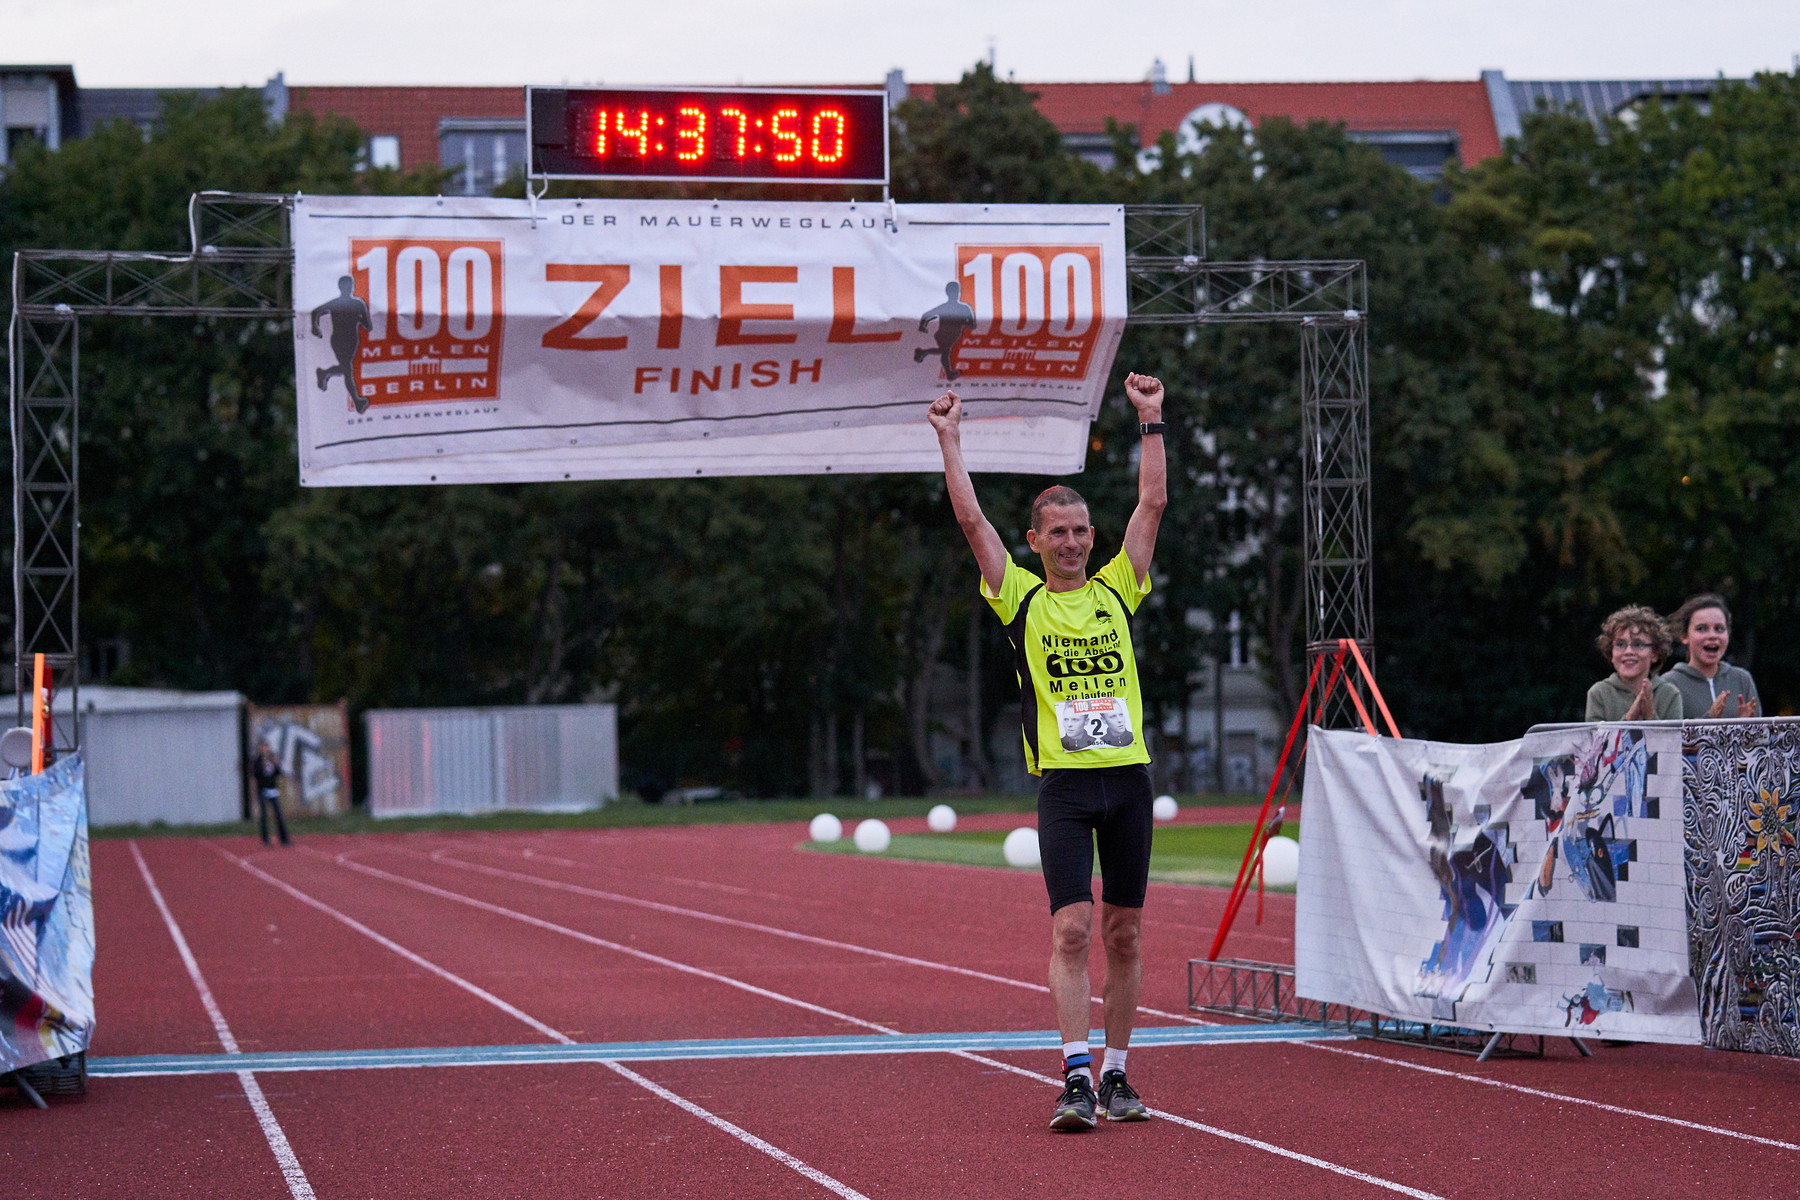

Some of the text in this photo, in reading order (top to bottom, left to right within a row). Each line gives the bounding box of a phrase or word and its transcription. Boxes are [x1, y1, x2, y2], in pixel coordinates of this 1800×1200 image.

[597, 107, 844, 162] 14:37:50
[561, 214, 896, 230] DER MAUERWEGLAUF
[356, 245, 494, 341] 100
[962, 251, 1094, 338] 100
[541, 262, 903, 351] ZIEL
[361, 344, 489, 358] MEILEN
[962, 338, 1084, 349] MEILEN
[955, 360, 1077, 373] BERLIN
[633, 357, 823, 395] FINISH
[361, 377, 488, 396] BERLIN
[1042, 628, 1119, 648] Niemand
[1063, 648, 1079, 657] die
[1051, 655, 1119, 675] 100
[1049, 676, 1126, 694] Meilen
[1065, 689, 1116, 701] zu laufen!
[1073, 701, 1089, 712] 100
[1090, 718, 1104, 736] 2
